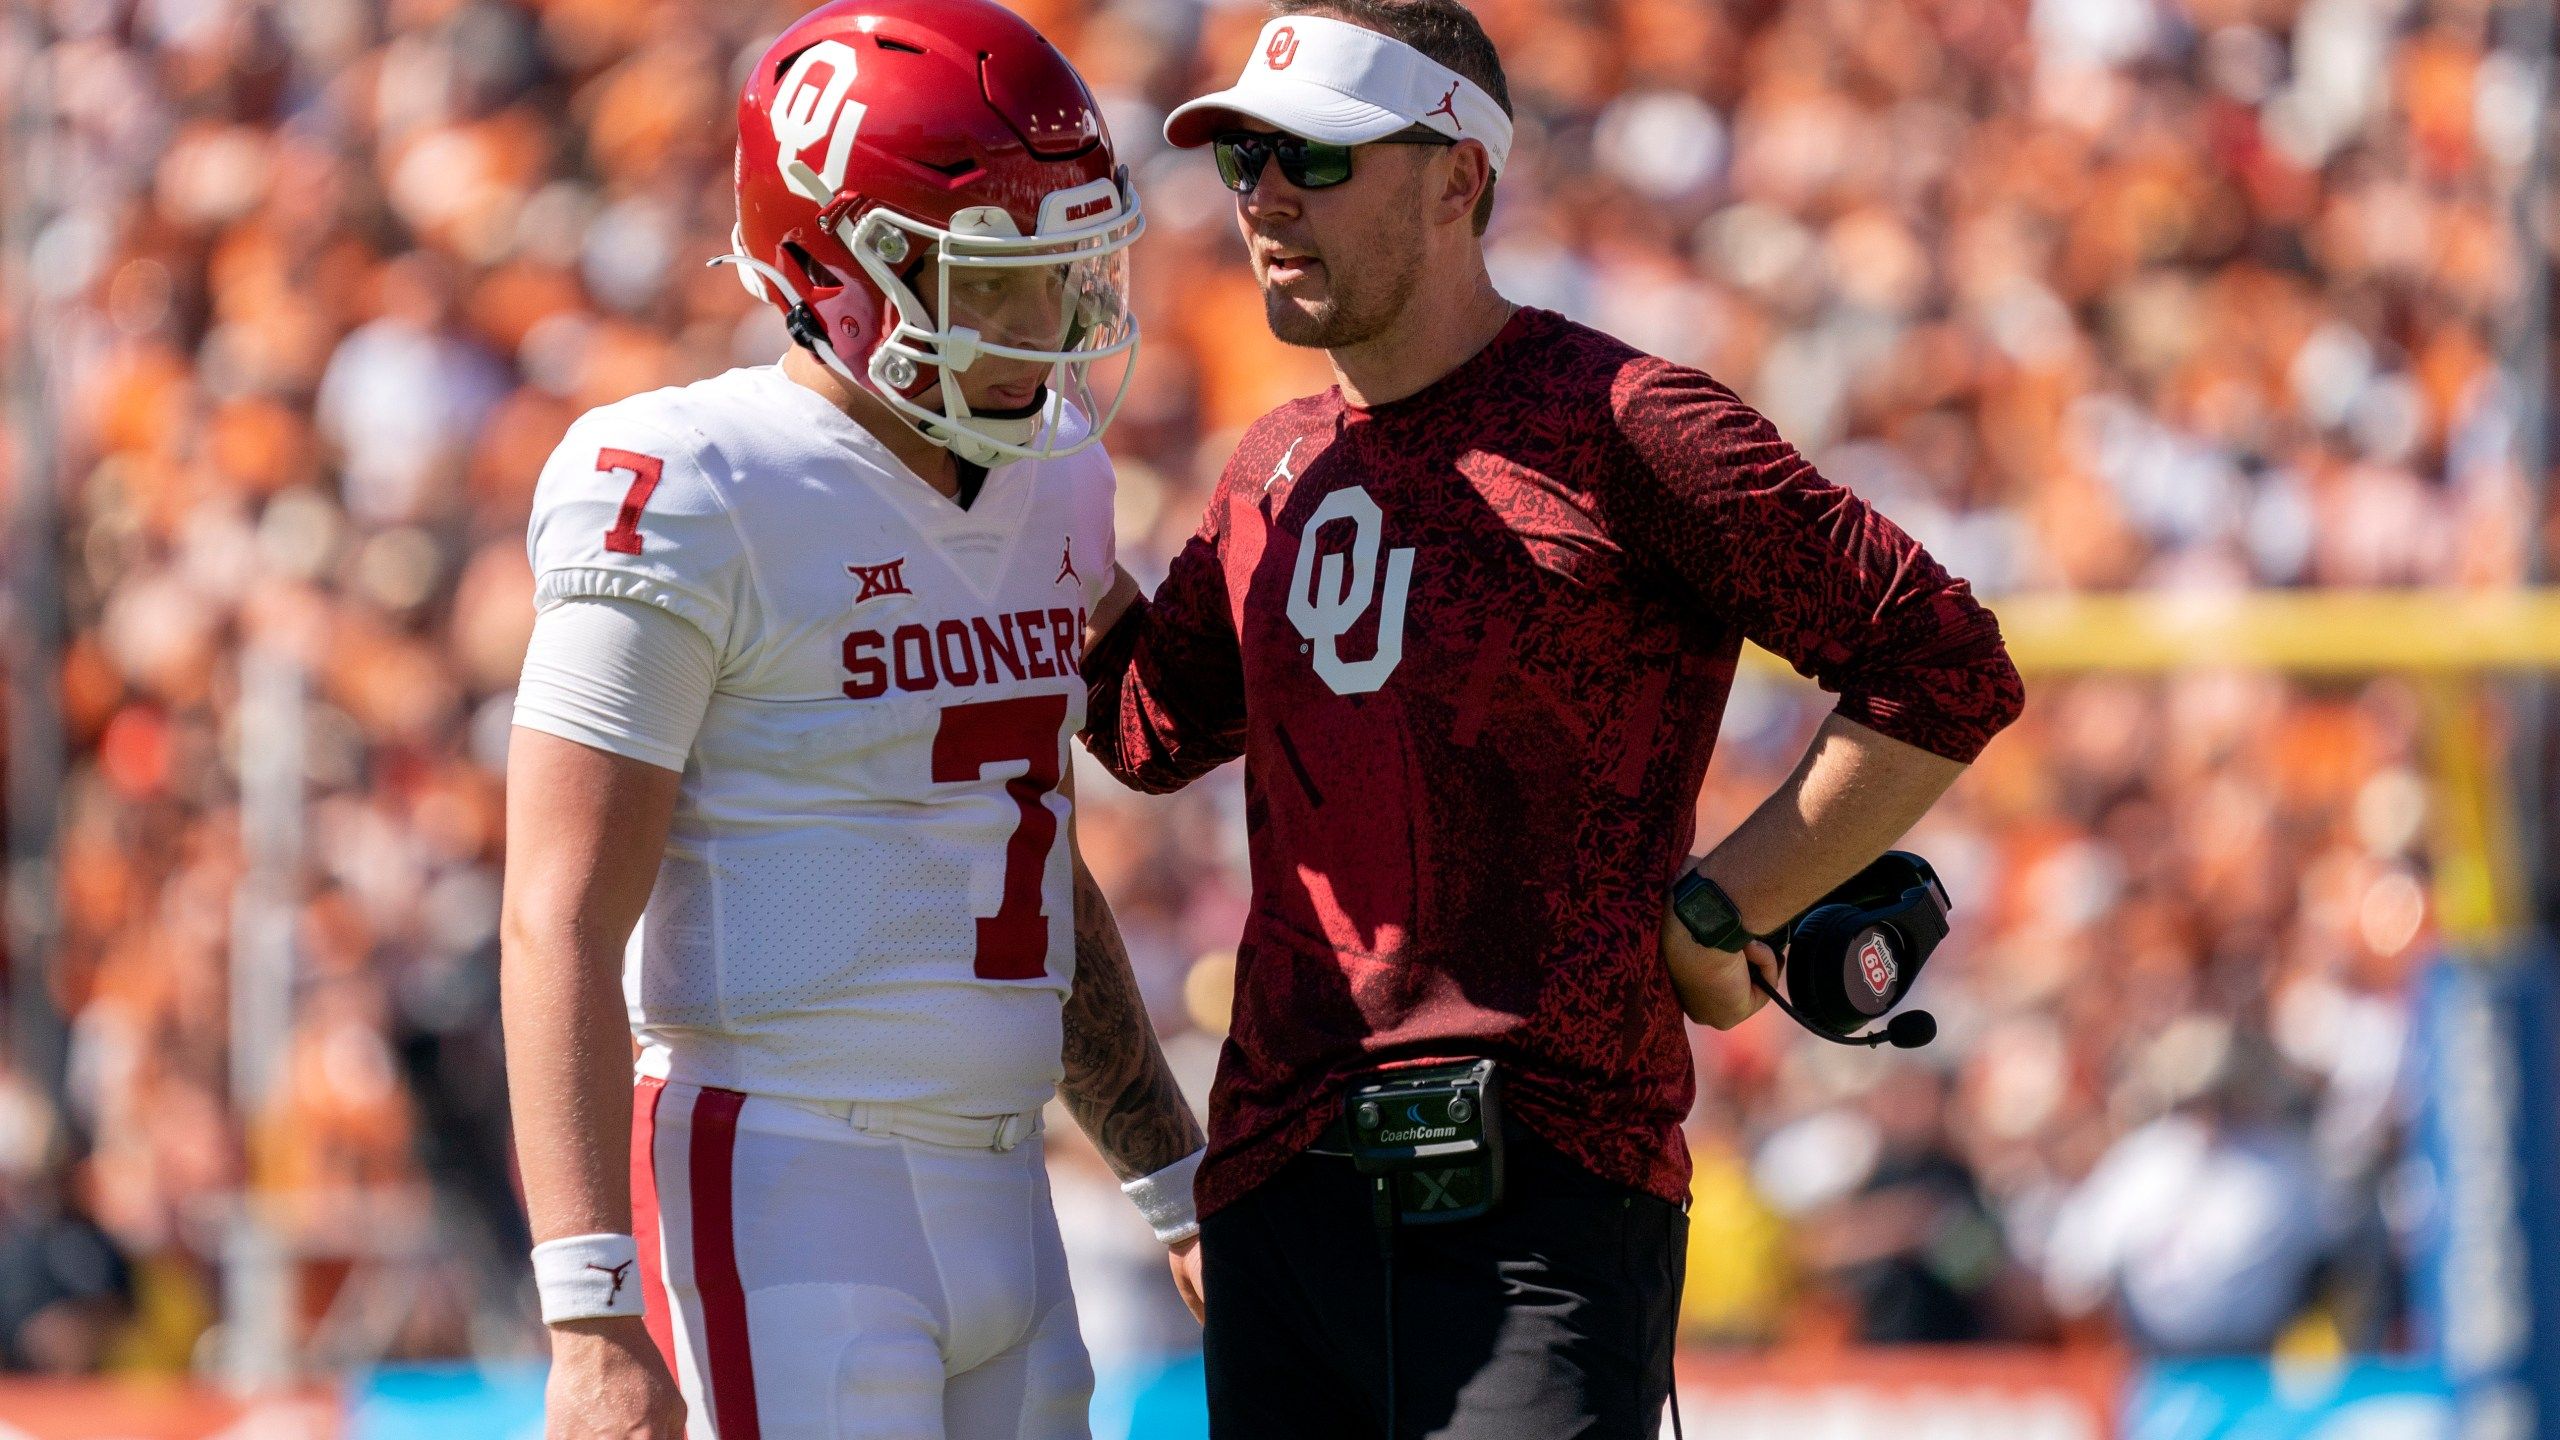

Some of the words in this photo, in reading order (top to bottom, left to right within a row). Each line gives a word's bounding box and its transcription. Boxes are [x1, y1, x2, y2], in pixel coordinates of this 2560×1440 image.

[770, 39, 868, 202] OU
[1065, 195, 1113, 221] OKLAHOMA
[596, 447, 664, 556] 7
[848, 557, 912, 603] XII
[1286, 485, 1415, 695] OU
[931, 694, 1068, 980] 7
[1864, 953, 1886, 982] 66
[1874, 939, 1895, 976] PHILLIPS
[1381, 1126, 1457, 1143] CoachComm
